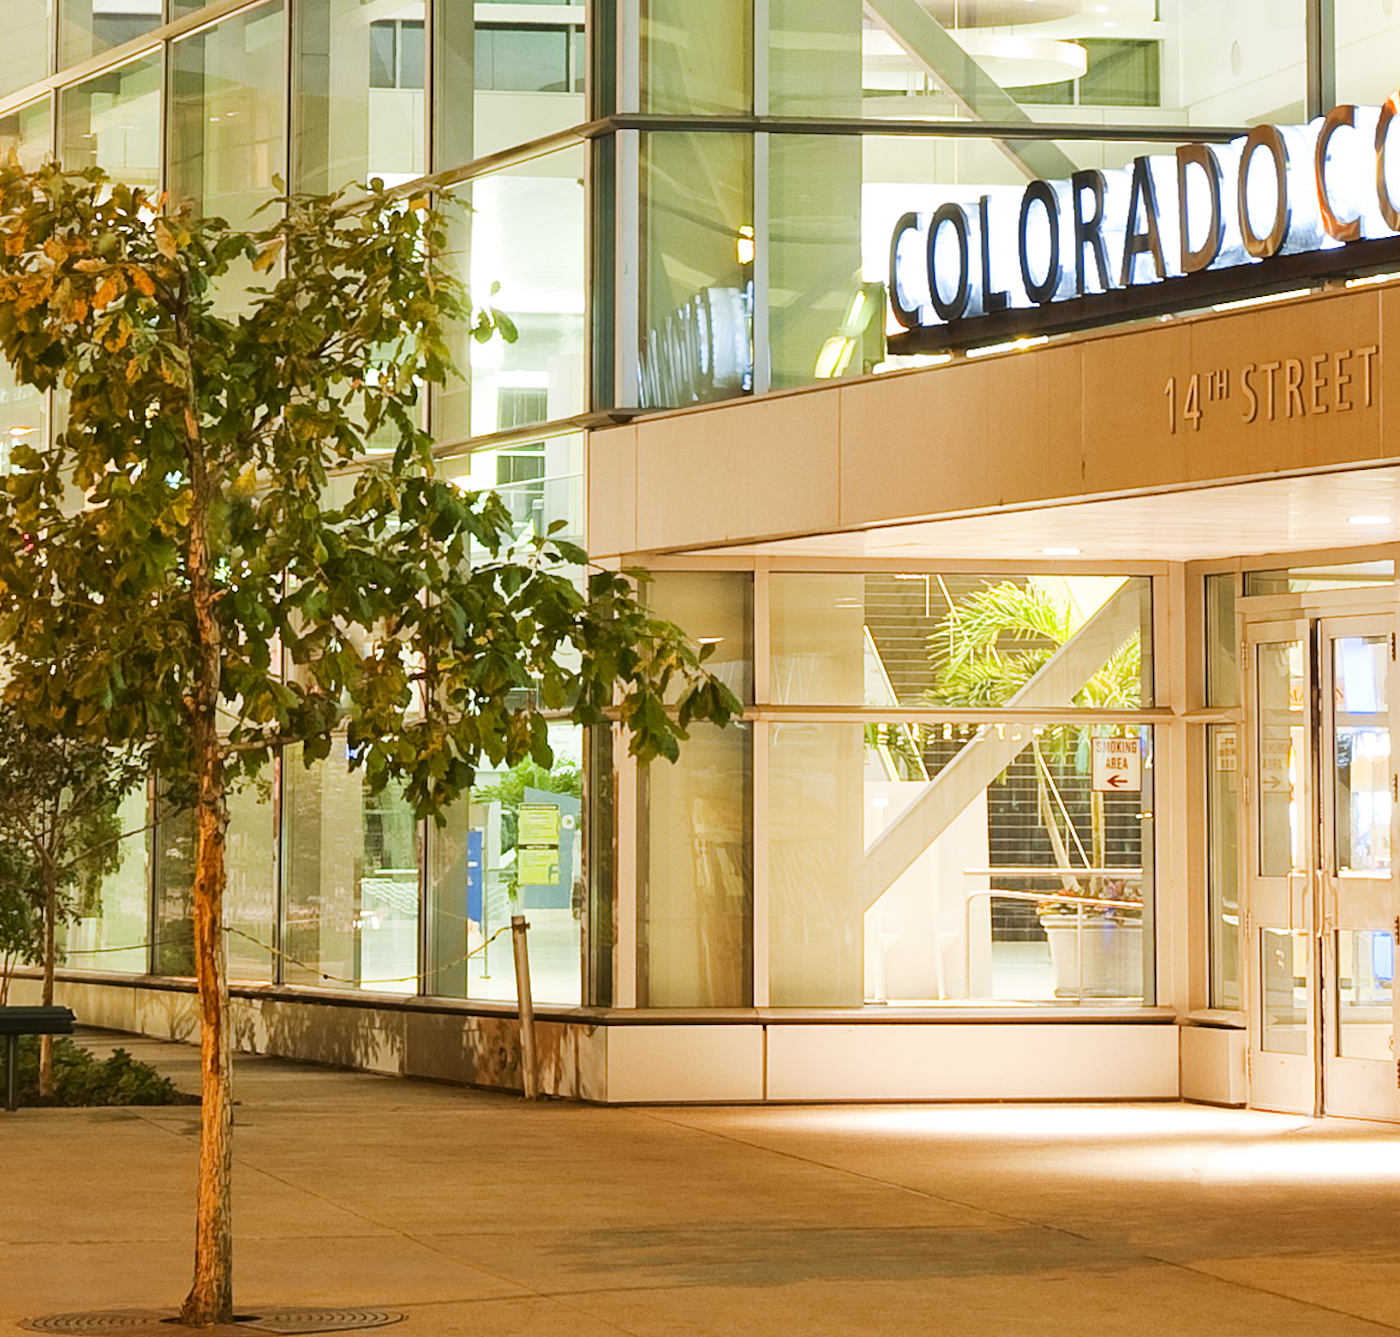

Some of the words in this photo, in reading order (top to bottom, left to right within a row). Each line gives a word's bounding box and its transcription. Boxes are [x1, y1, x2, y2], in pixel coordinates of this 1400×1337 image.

[889, 124, 1292, 328] COLORADO
[1164, 369, 1230, 434] 14TH
[1241, 345, 1378, 423] STREET
[1096, 741, 1137, 754] SMOKING
[1105, 757, 1128, 770] AREA
